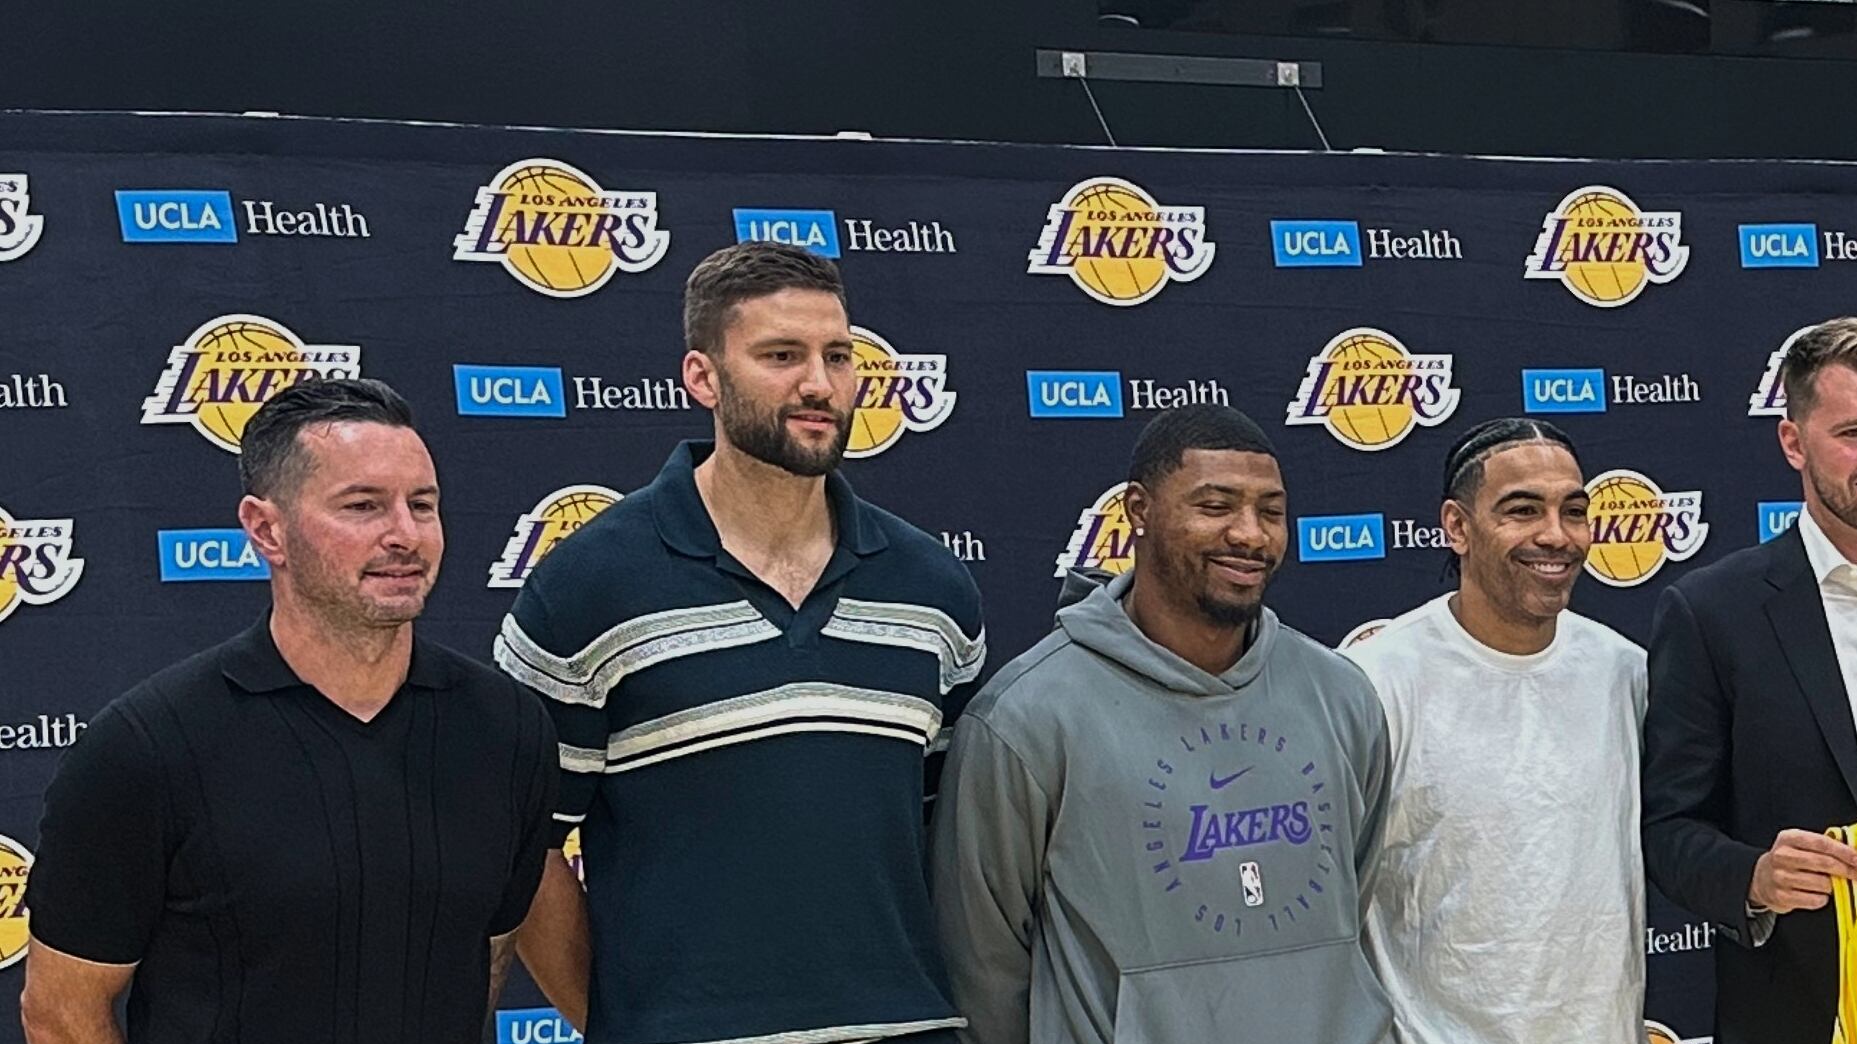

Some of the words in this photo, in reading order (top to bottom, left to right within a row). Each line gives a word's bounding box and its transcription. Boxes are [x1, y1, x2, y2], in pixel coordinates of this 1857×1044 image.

[519, 194, 556, 207] LOS
[559, 194, 649, 210] ANGELES
[134, 203, 222, 230] UCLA
[246, 201, 371, 237] Health
[474, 193, 651, 264] LAKERS
[1087, 211, 1120, 222] LOS
[1121, 211, 1197, 224] ANGELES
[1578, 217, 1608, 227] LOS
[1609, 217, 1674, 227] ANGELES
[749, 220, 826, 246] UCLA
[846, 220, 955, 253] Health
[1046, 209, 1197, 275] LAKERS
[1284, 233, 1351, 255] UCLA
[1367, 229, 1462, 260] Health
[1542, 217, 1672, 271] LAKERS
[1752, 235, 1809, 257] UCLA
[215, 350, 253, 362] LOS
[256, 349, 350, 363] ANGELES
[855, 360, 937, 371] ANGELES
[1343, 359, 1373, 371] LOS
[1374, 359, 1444, 371] ANGELES
[0, 373, 66, 407] alth
[159, 352, 350, 414] LAKE
[470, 376, 552, 404] UCLA
[574, 376, 690, 411] Health
[855, 376, 937, 420] ERS
[1041, 381, 1112, 408] UCLA
[1130, 380, 1228, 408] Health
[1306, 361, 1442, 416] LAKERS
[1534, 380, 1596, 402] UCLA
[1612, 374, 1700, 404] Health
[1600, 500, 1628, 510] LOS
[1630, 497, 1695, 509] ANGELES
[0, 525, 62, 539] GELES
[559, 520, 582, 532] LO
[1309, 525, 1374, 550] UCLA
[1392, 521, 1453, 548] Hea
[1584, 509, 1694, 553] AKERS
[1769, 511, 1800, 533] UC
[175, 540, 259, 569] UCLA
[0, 714, 87, 748] ealth
[1180, 723, 1287, 752] LAKERS
[1143, 759, 1182, 892] ANGELES
[1179, 801, 1312, 862] LAKERS
[1195, 904, 1243, 937] LOS
